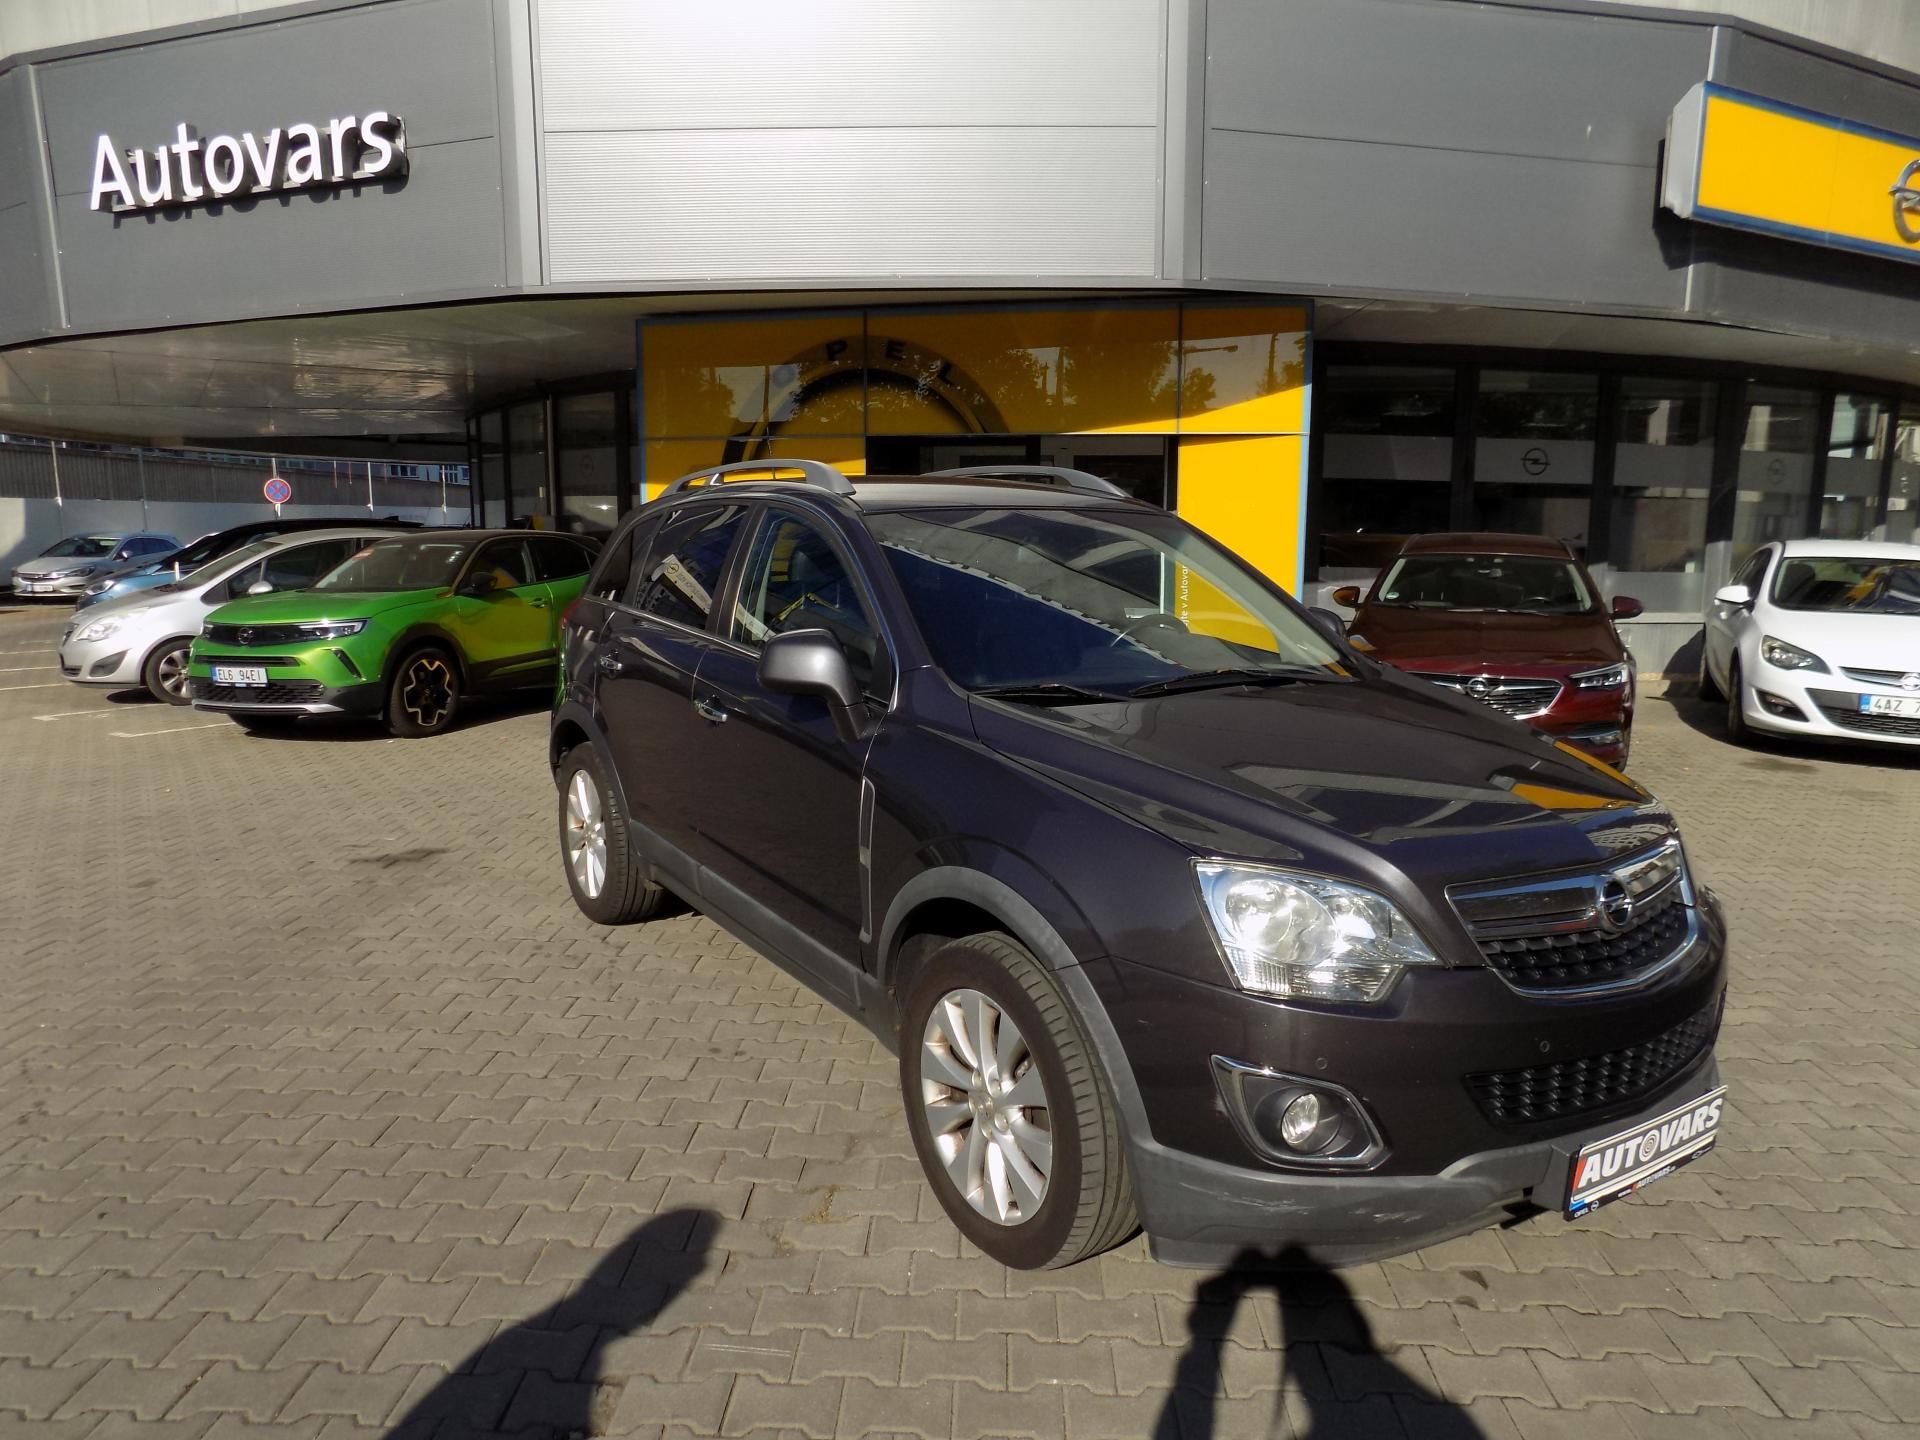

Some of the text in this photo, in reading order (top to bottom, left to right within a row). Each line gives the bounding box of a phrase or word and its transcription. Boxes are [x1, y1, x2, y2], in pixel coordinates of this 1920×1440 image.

[90, 111, 393, 211] Autovars
[1180, 565, 1189, 601] Autovar
[1874, 698, 1903, 712] 4AZ
[1578, 1098, 1723, 1189] AUTOVARS
